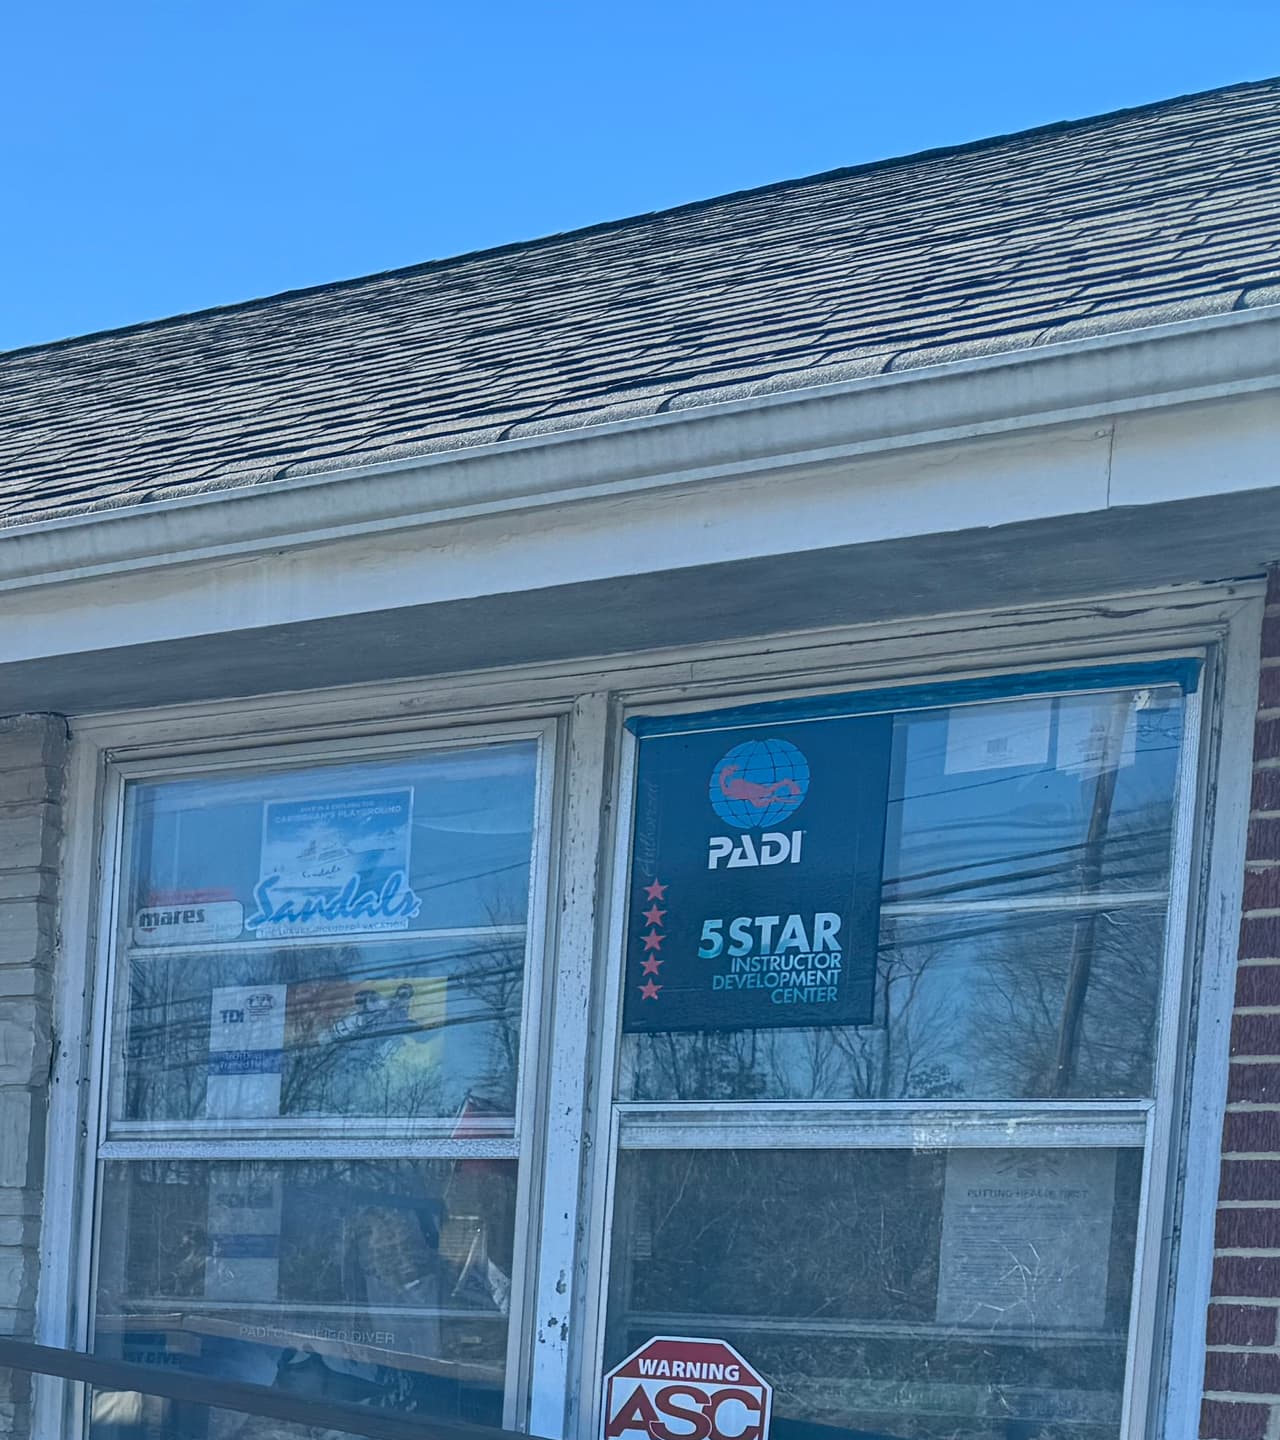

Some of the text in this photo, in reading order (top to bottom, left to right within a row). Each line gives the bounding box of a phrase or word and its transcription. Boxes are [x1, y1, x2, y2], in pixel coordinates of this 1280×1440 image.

[708, 830, 802, 870] PADI
[246, 871, 418, 929] Sandals
[139, 908, 205, 928] mares
[731, 952, 841, 973] INSTRUCTOR
[712, 969, 842, 990] DEVELOPMENT
[770, 986, 838, 1005] CENTER
[638, 1358, 740, 1382] WARNING
